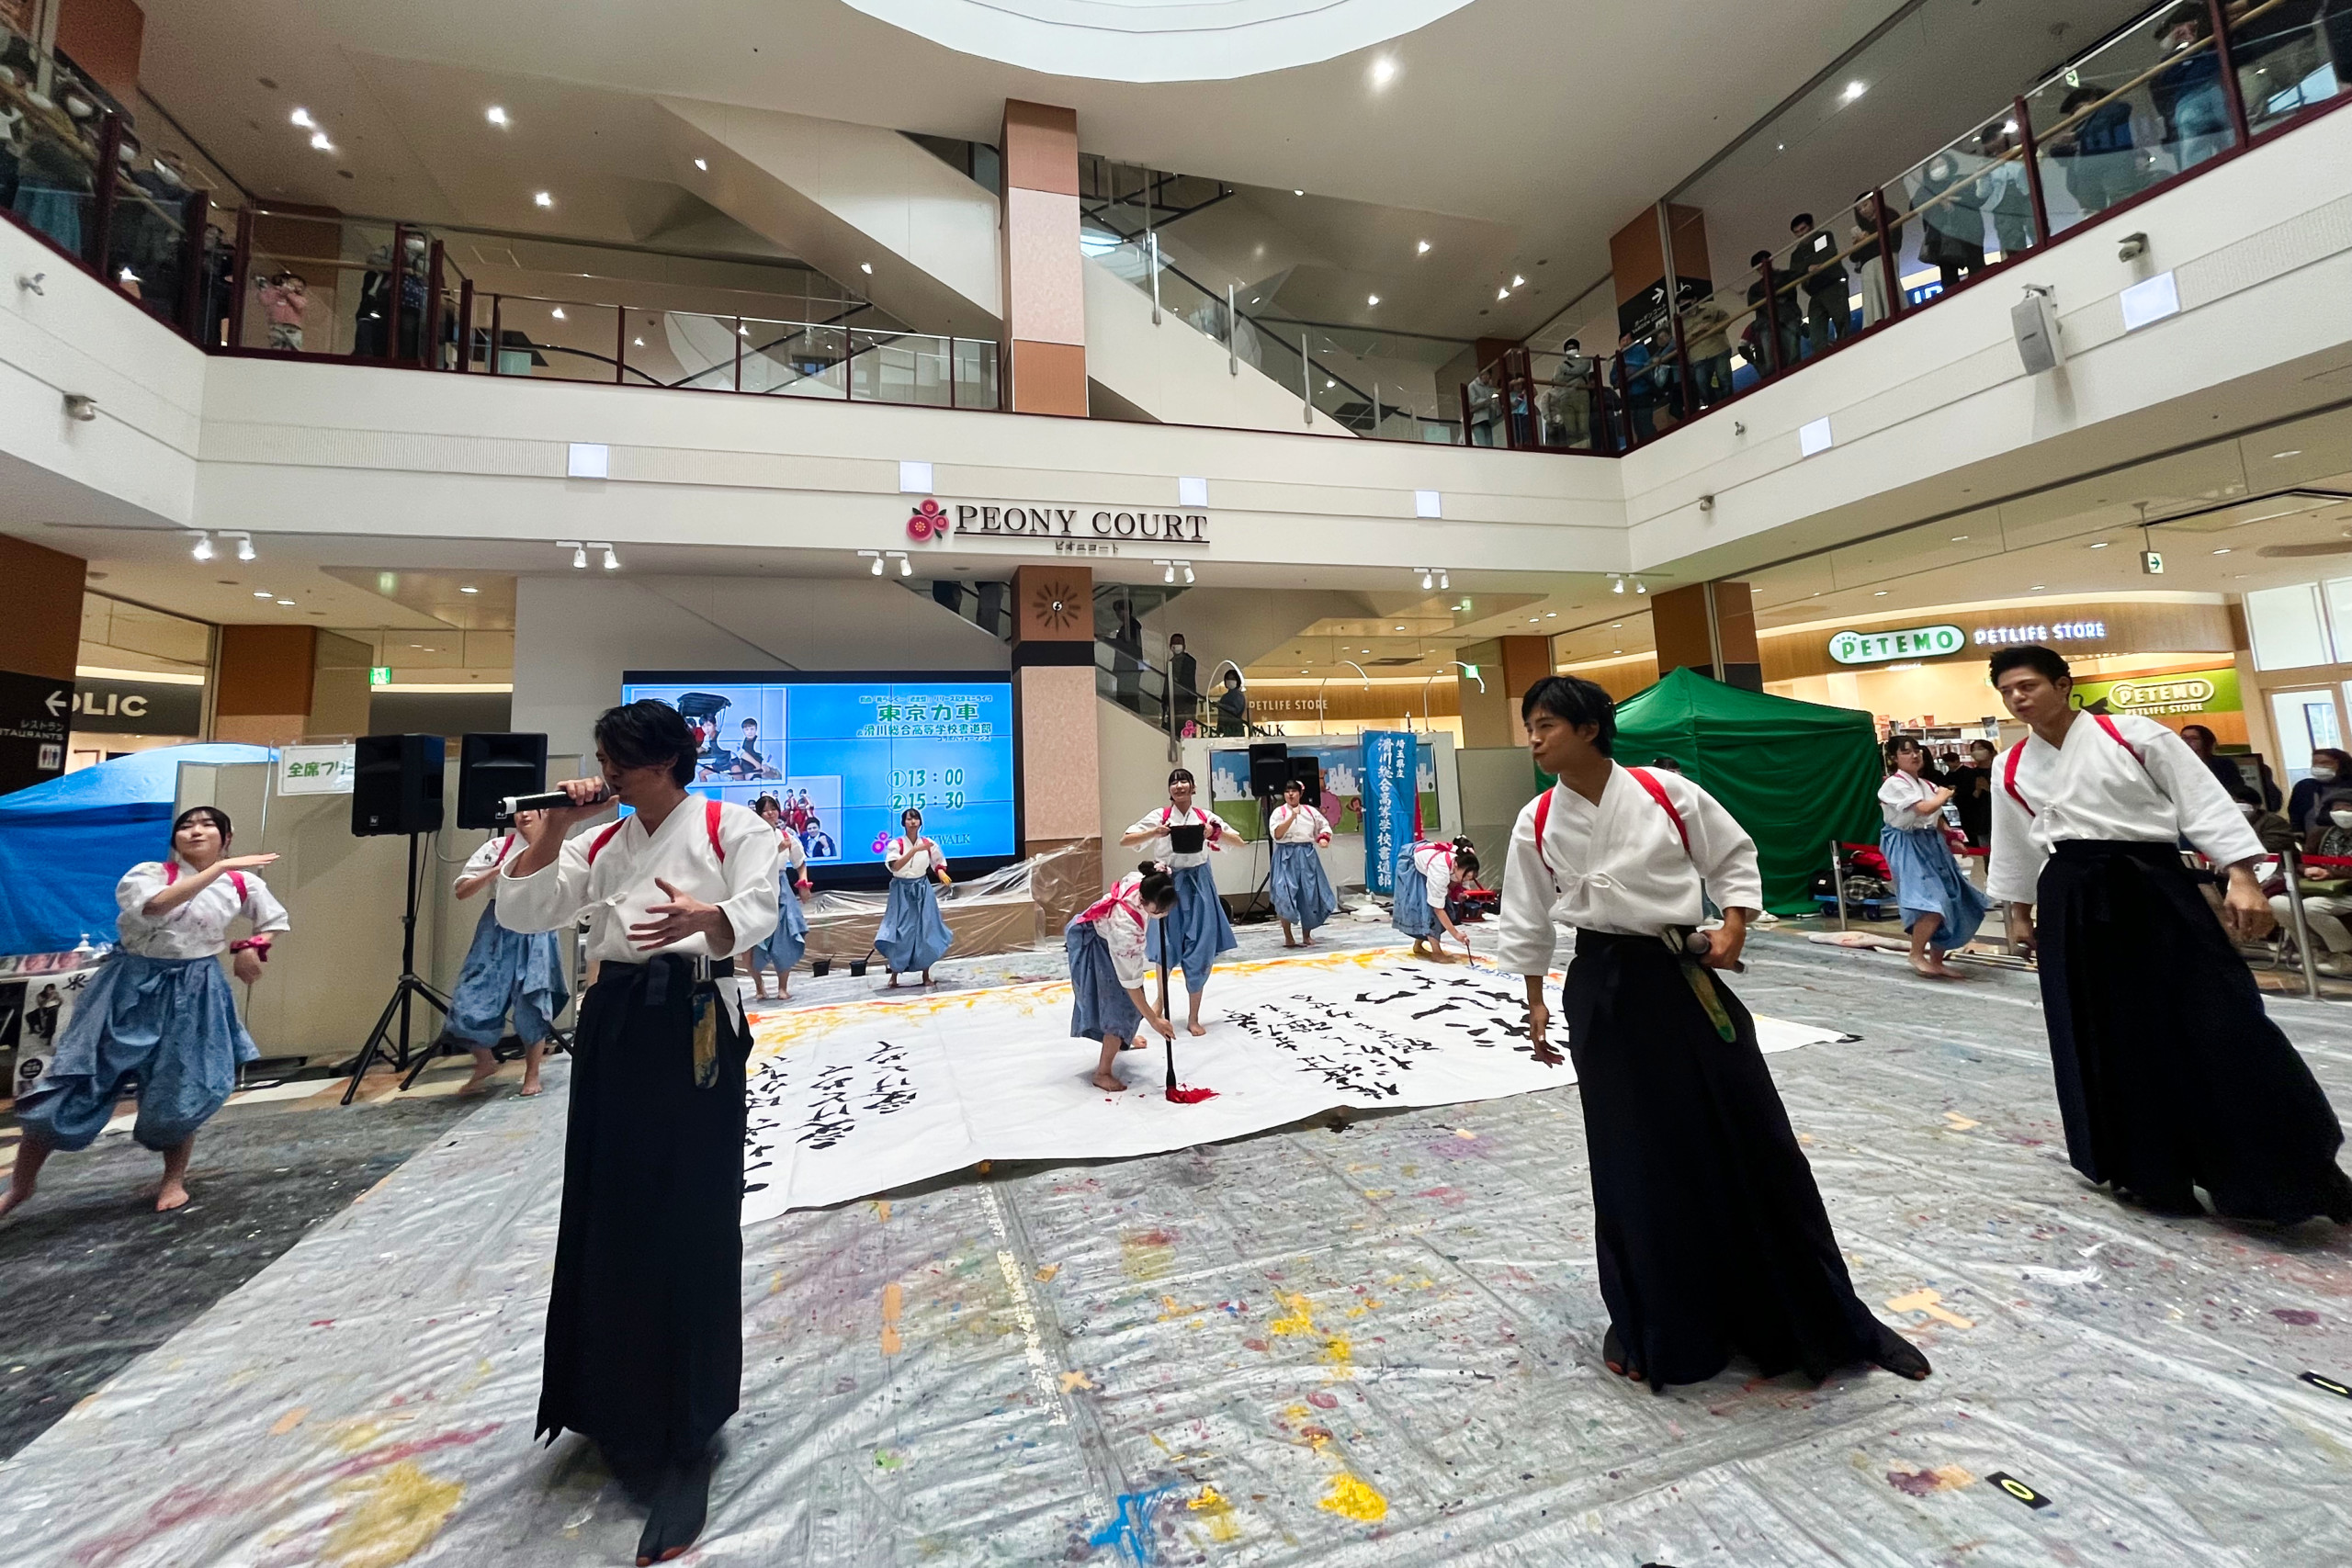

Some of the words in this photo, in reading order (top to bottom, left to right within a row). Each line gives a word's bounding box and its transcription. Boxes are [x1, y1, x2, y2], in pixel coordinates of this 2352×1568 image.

[956, 504, 1078, 536] PEONY
[1091, 511, 1208, 541] COURT
[1841, 630, 1954, 660] PETEMO
[1974, 626, 2047, 646] PETLIFE
[2052, 622, 2106, 640] STORE
[1249, 700, 1291, 711] PETLIFE
[1295, 699, 1329, 710] STORE
[2119, 682, 2205, 705] PETEMO
[877, 704, 978, 722] 東京力車
[2125, 705, 2166, 716] PETLIFE
[2168, 703, 2203, 714] STORE
[20, 720, 64, 732] レストラン
[1396, 739, 1406, 779] 埼玉県立
[1376, 738, 1395, 888] 滑川総合高等学校書道部
